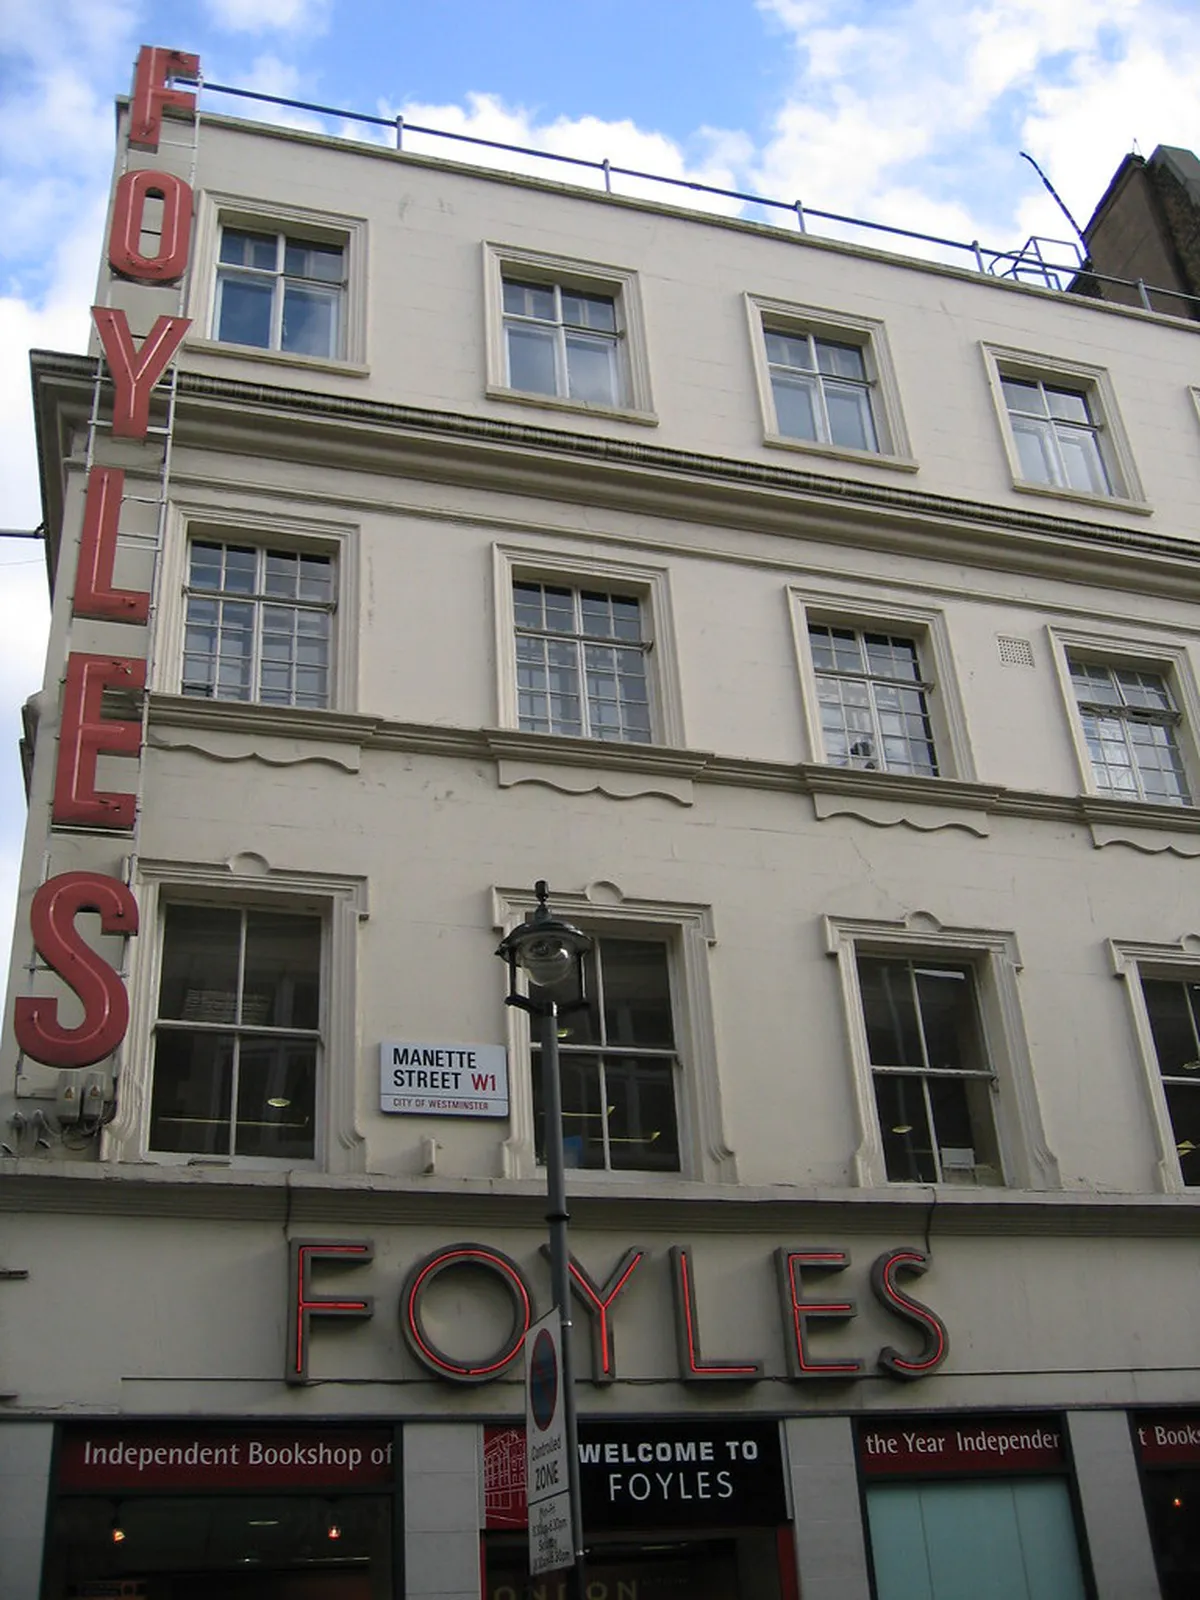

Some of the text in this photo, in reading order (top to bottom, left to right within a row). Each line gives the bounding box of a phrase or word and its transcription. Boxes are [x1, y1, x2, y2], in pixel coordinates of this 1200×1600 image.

[14, 44, 201, 1068] FOYLES
[393, 1048, 477, 1069] MANETTE
[393, 1069, 497, 1092] STREET W1
[393, 1098, 489, 1110] CITY OF WESTMINSTER
[287, 1236, 950, 1386] FOYLES
[84, 1441, 394, 1471] Independent Bookshop of
[578, 1440, 759, 1464] WELCOME TO
[866, 1433, 898, 1454] the
[902, 1432, 945, 1453] Year
[535, 1460, 559, 1490] ZONE
[608, 1470, 734, 1502] FOYLES
